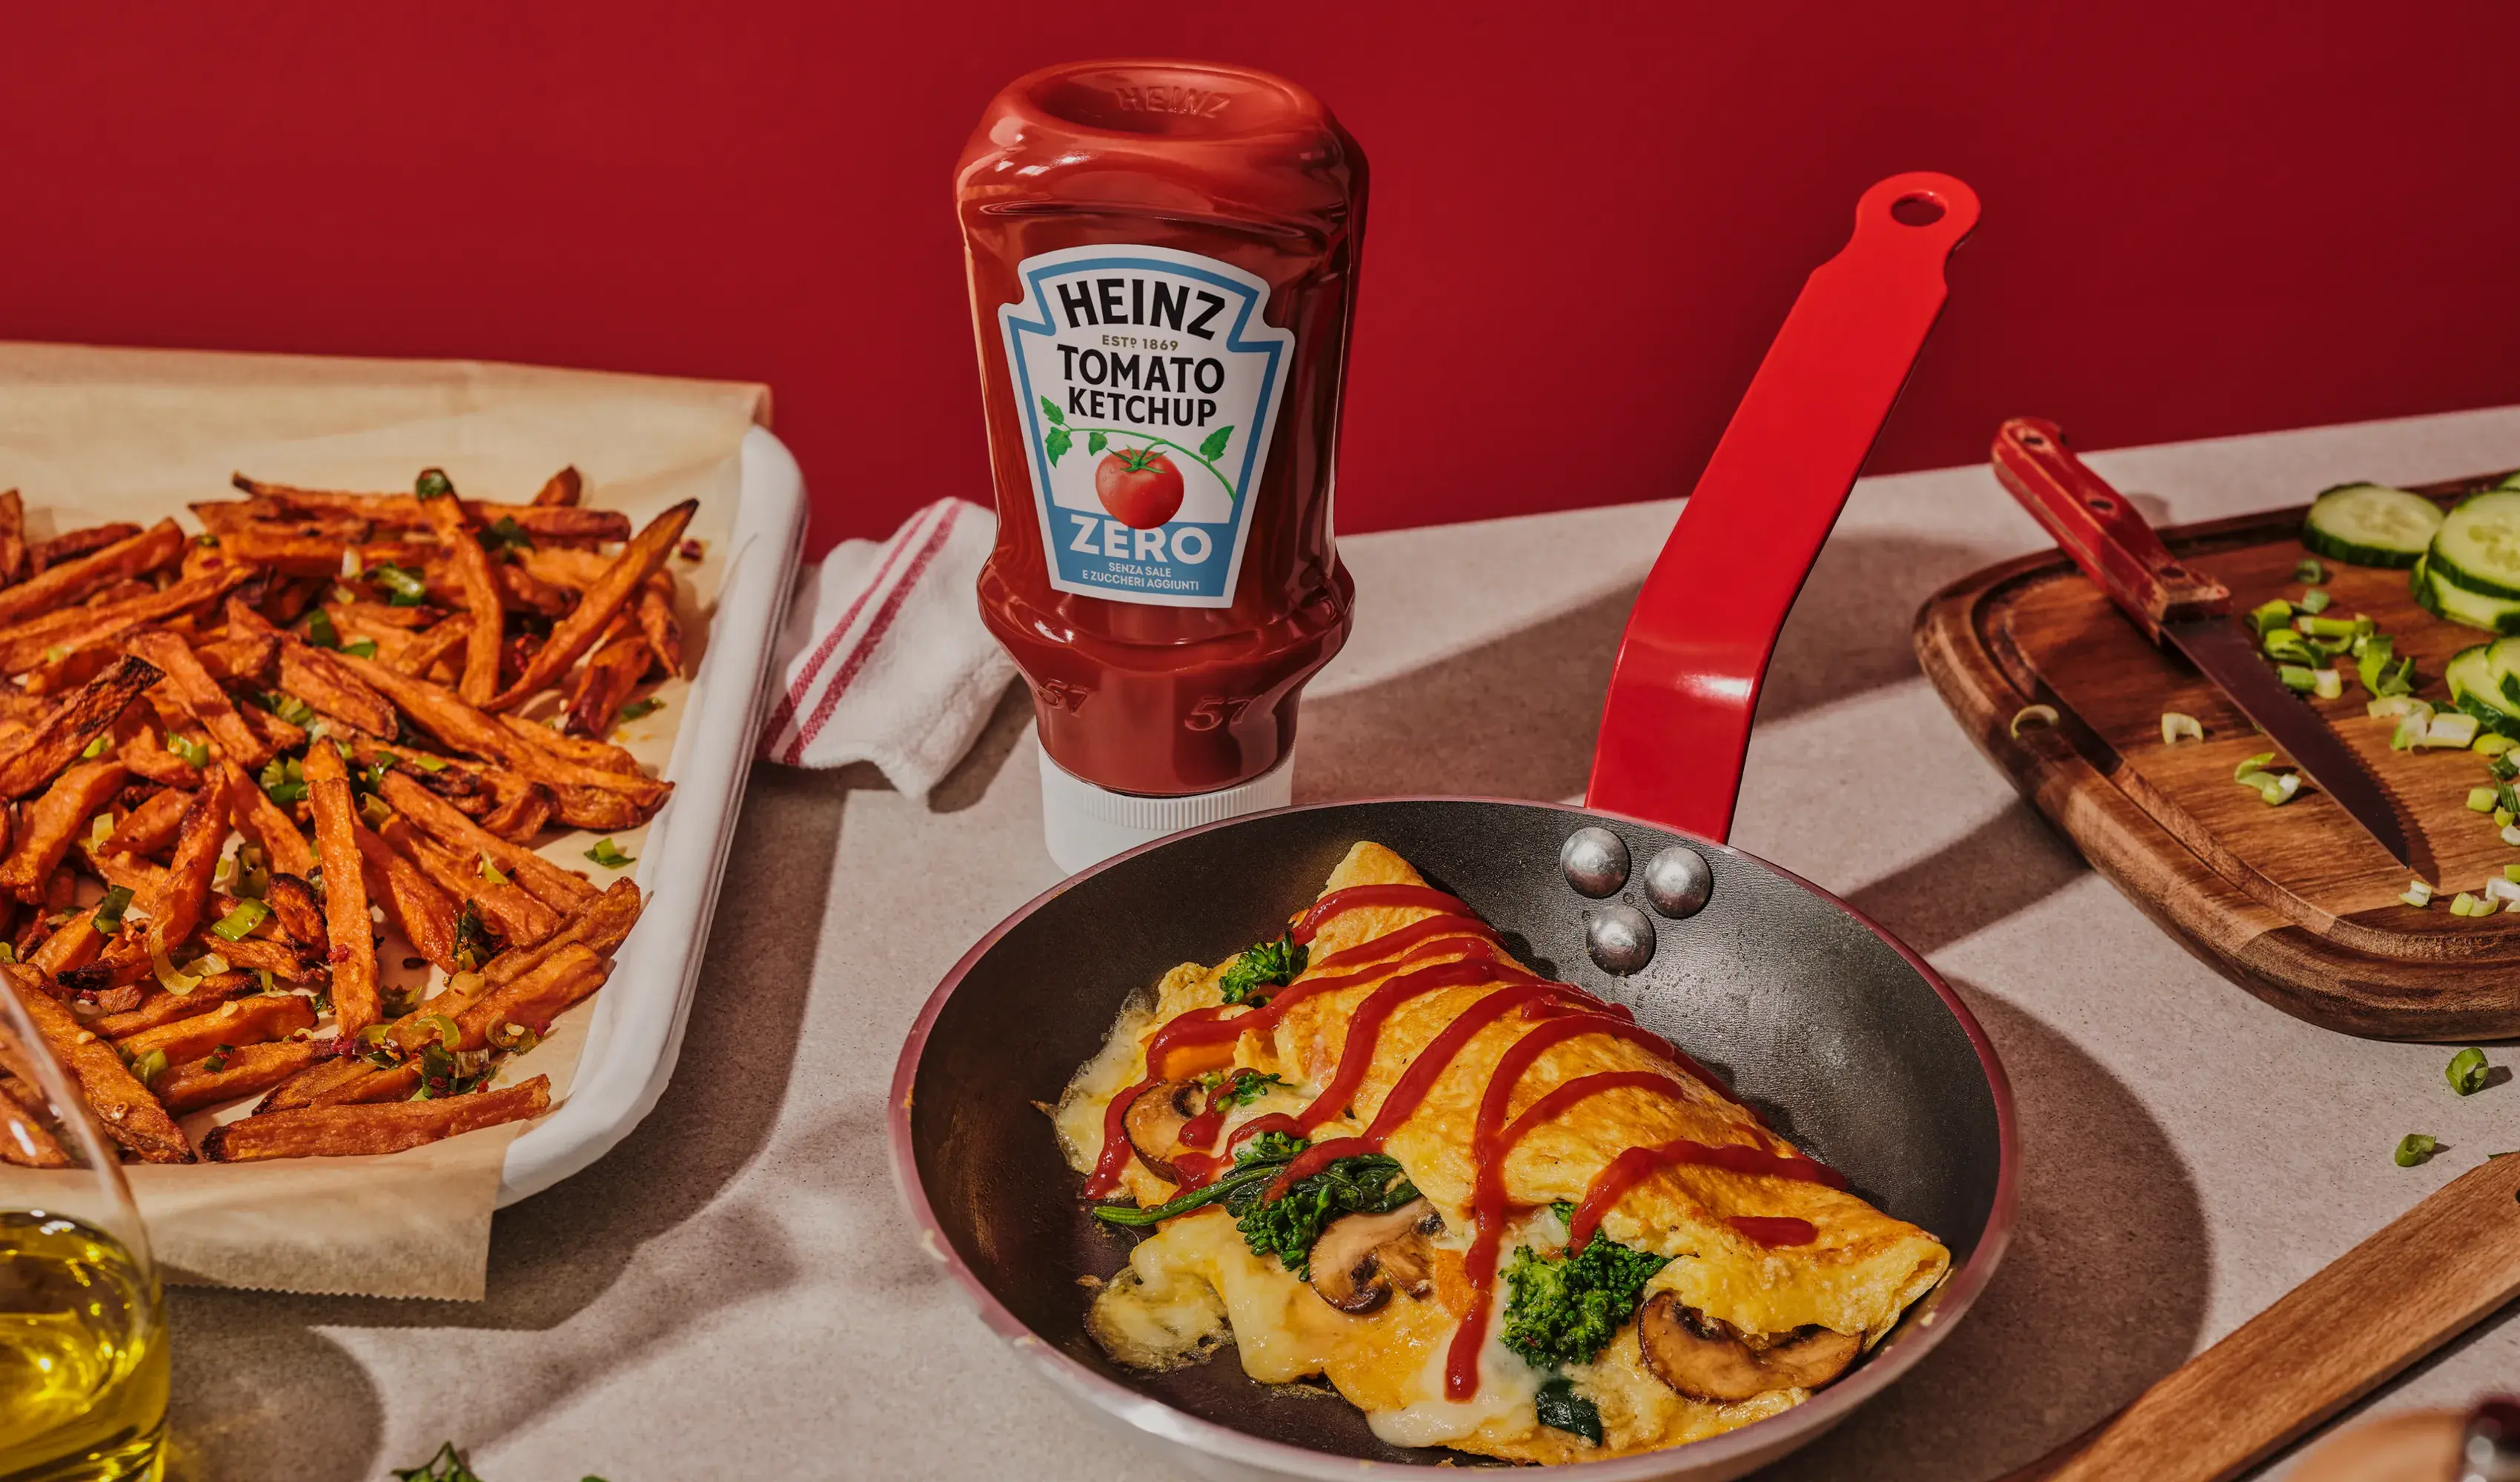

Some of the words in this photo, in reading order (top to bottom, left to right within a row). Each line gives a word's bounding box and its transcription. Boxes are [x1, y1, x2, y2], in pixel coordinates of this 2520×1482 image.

[1115, 86, 1231, 119] HEINZ
[1056, 279, 1226, 341] HEINZ
[1142, 339, 1179, 351] 1869
[1056, 343, 1225, 394] TOMATO
[1068, 386, 1217, 428] KETCHUP
[1070, 514, 1213, 565] ZERO
[1082, 570, 1088, 579] E
[1090, 571, 1144, 587] ZUCCHERI
[1147, 578, 1198, 591] AGGIUNTI
[1109, 562, 1143, 575] SENZA
[1145, 566, 1171, 577] SALE
[1185, 696, 1253, 731] 57
